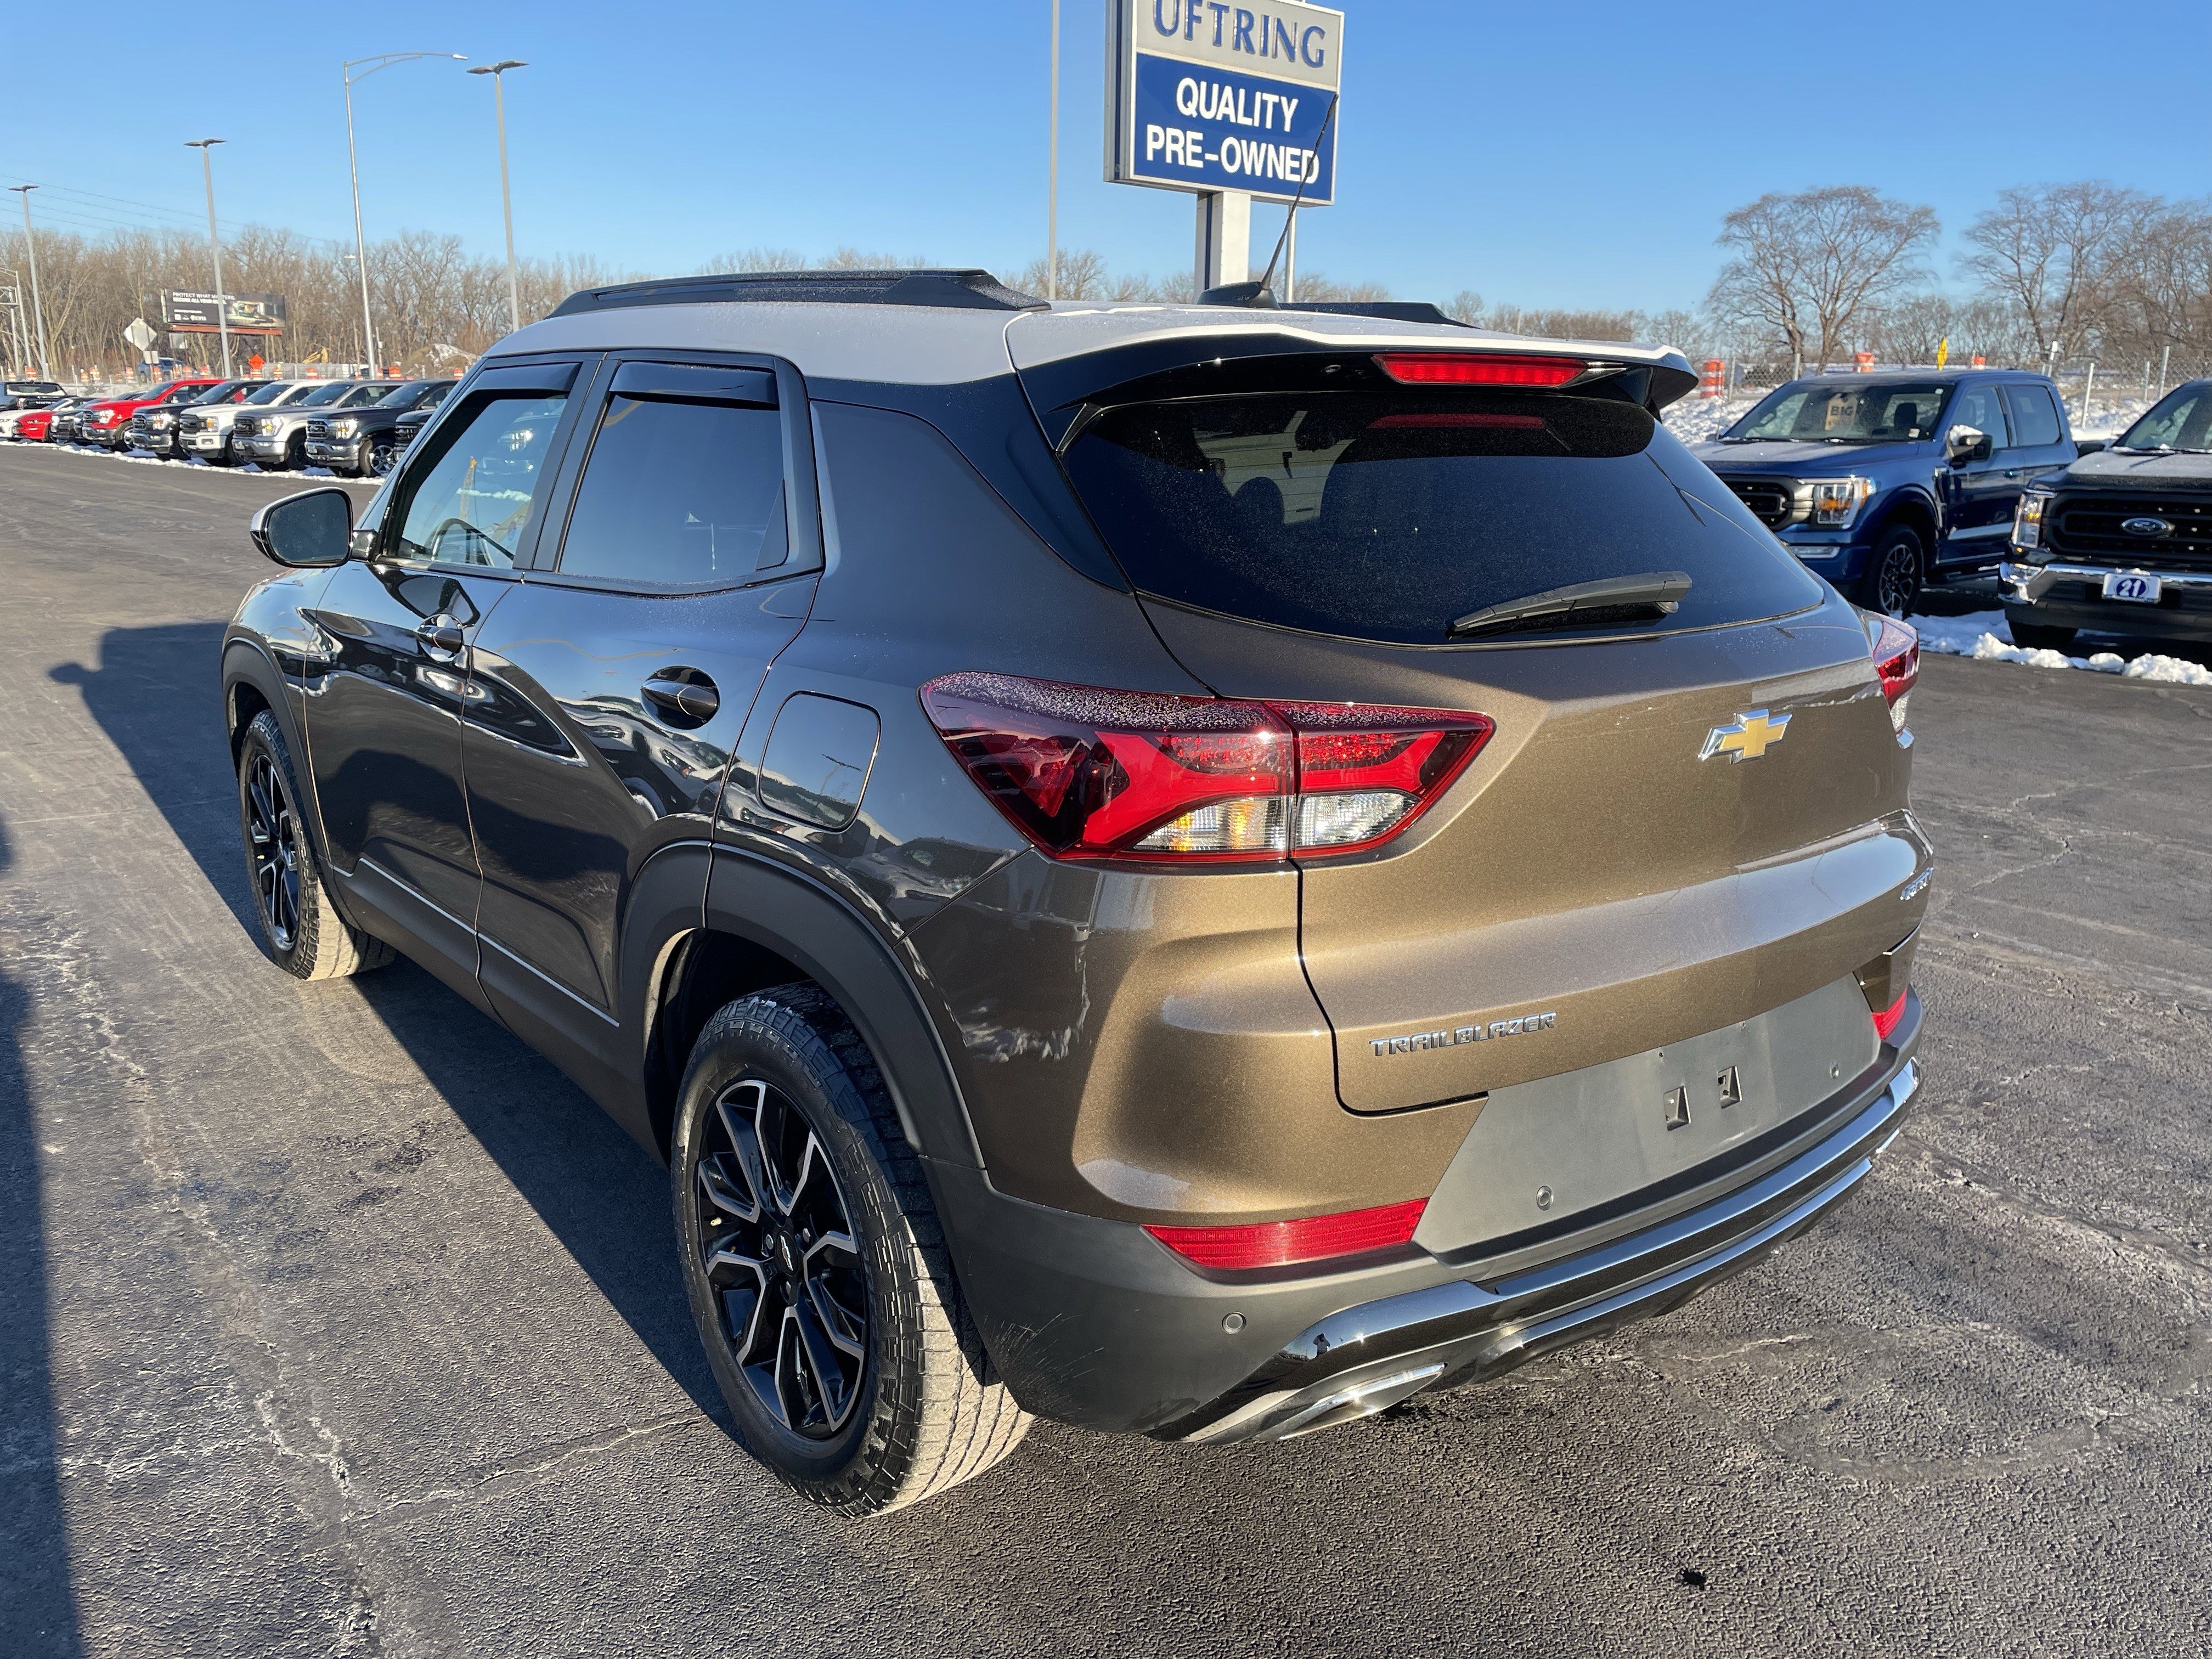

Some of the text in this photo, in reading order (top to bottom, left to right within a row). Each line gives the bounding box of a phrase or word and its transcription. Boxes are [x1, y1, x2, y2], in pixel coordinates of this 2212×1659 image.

[1153, 0, 1325, 68] UFTRING
[1176, 77, 1299, 133] QUALITY
[1146, 124, 1320, 184] PRE-OWNED
[1831, 406, 1853, 416] BIG
[2119, 579, 2142, 598] 21
[1369, 1011, 1557, 1057] TRAILBLAZER
